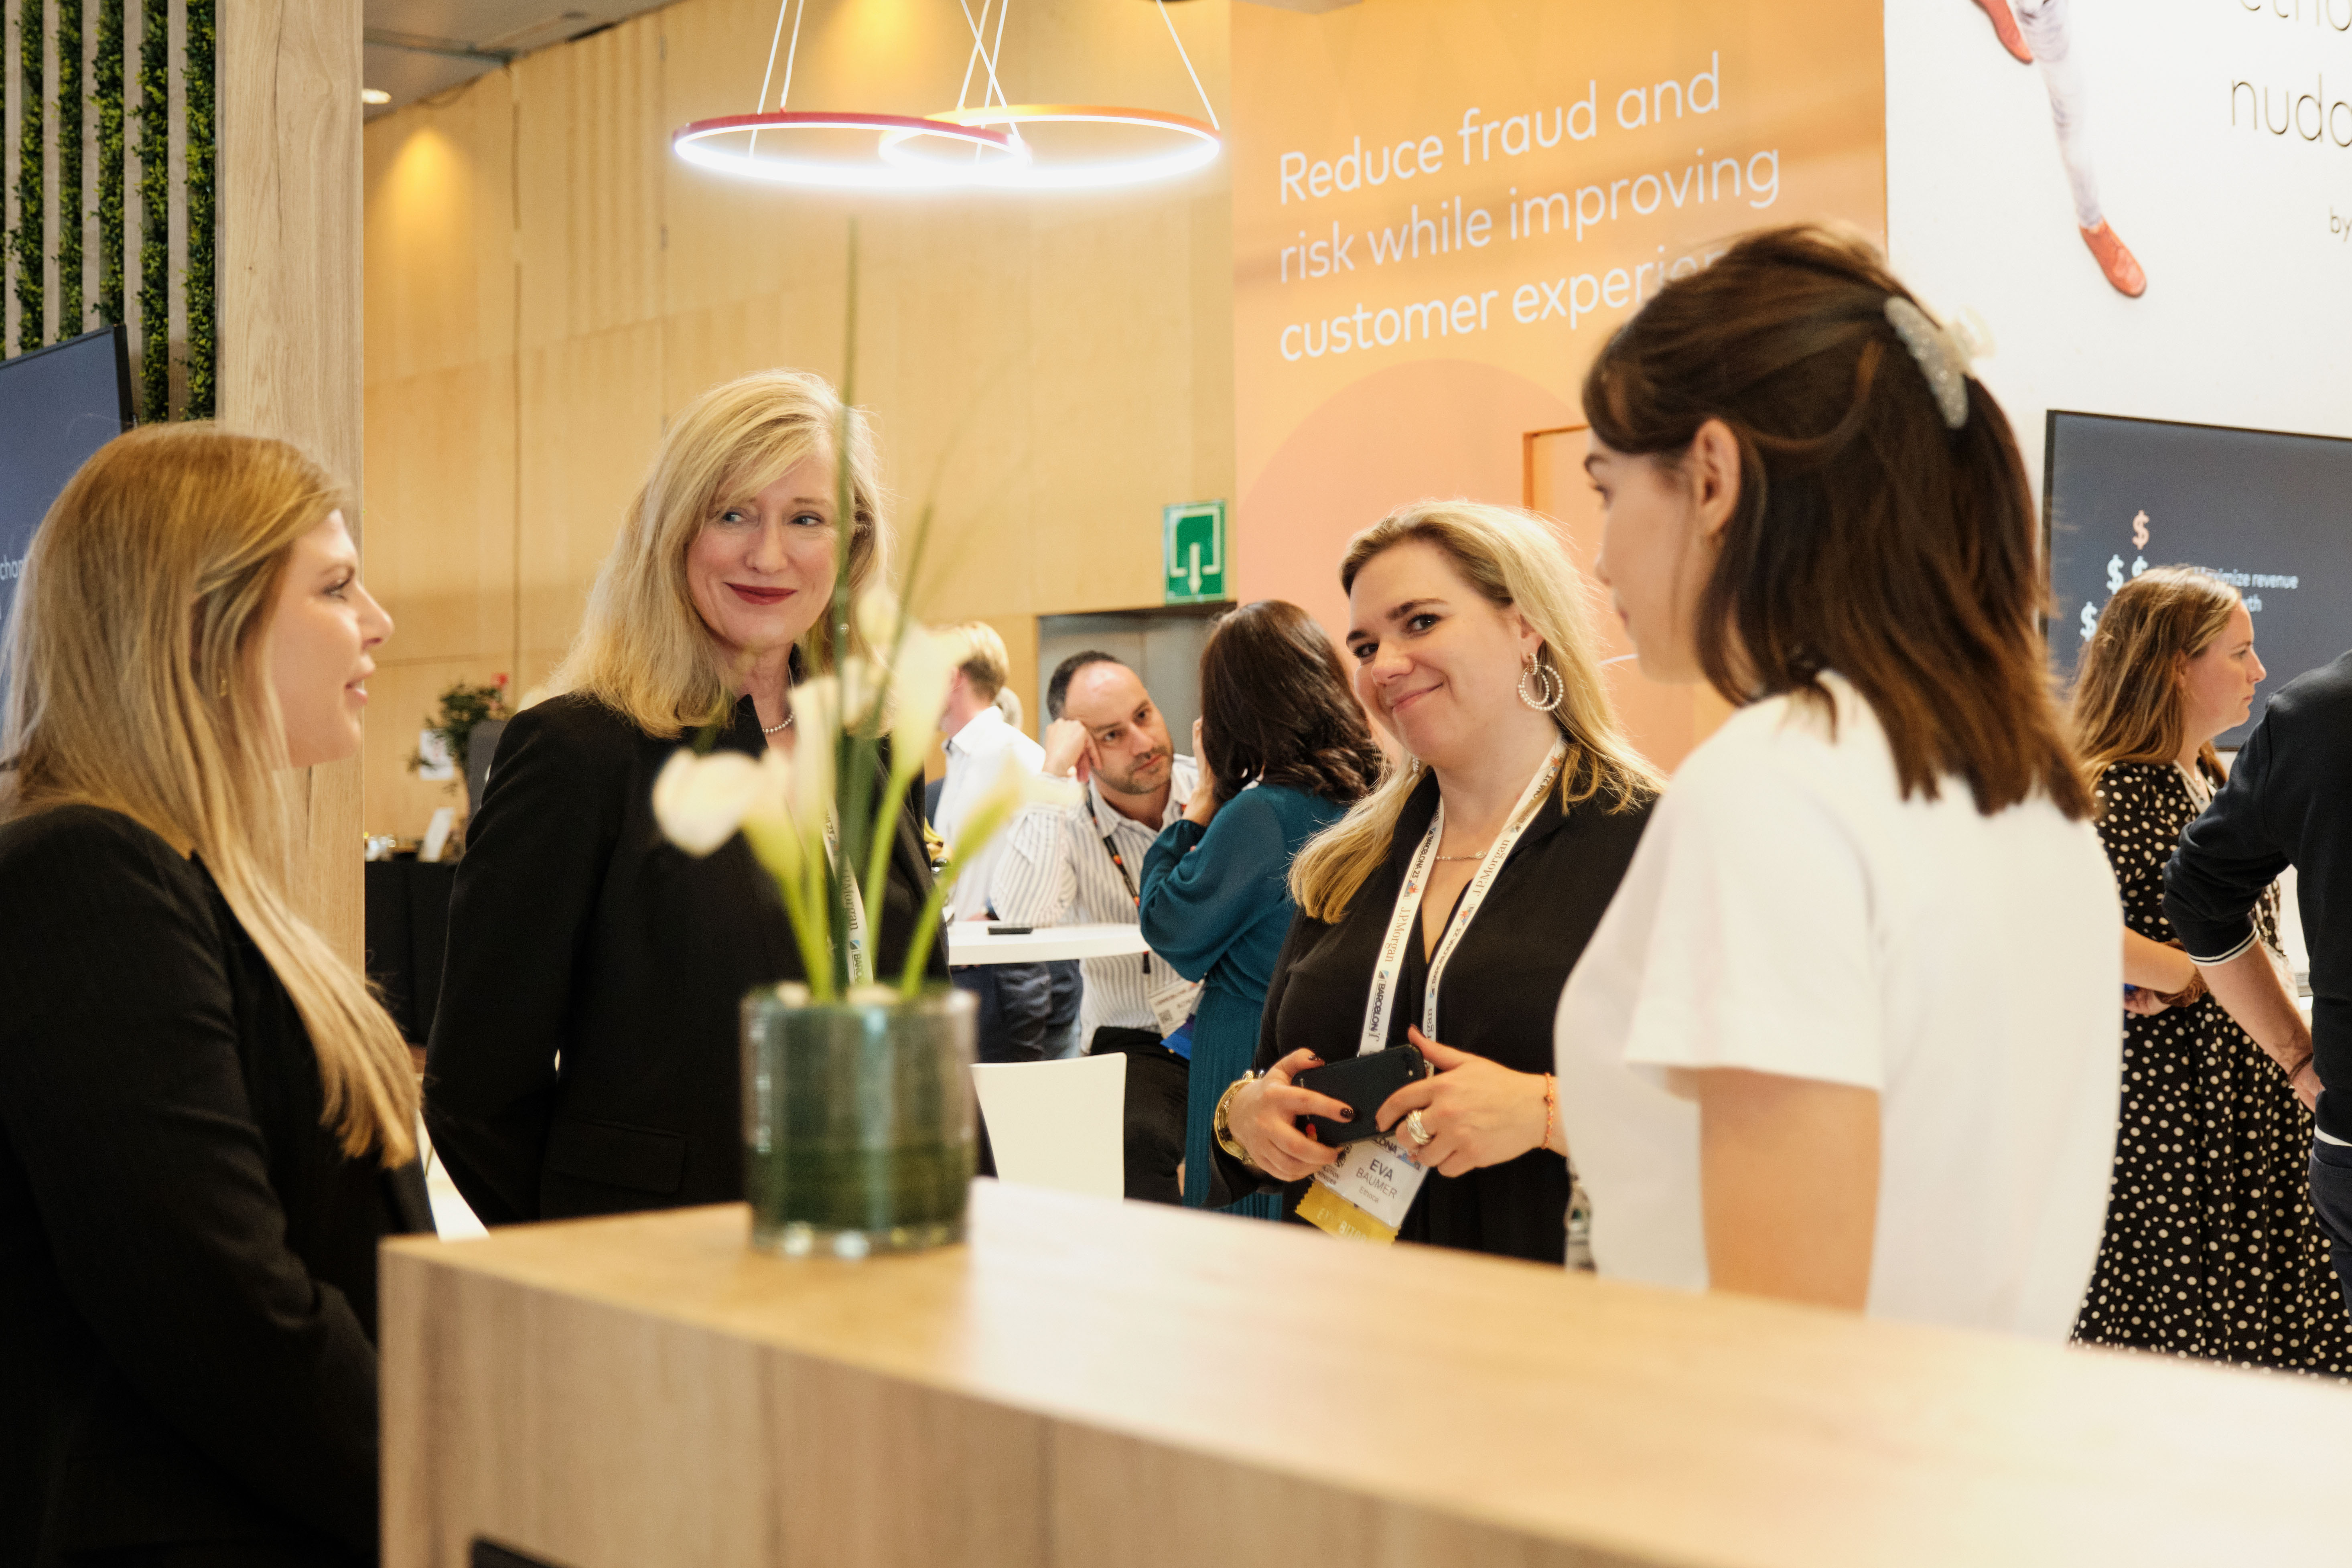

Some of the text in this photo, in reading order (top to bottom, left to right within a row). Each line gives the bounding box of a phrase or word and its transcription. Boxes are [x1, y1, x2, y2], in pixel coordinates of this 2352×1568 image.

[1280, 50, 1719, 205] Reduce fraud and
[1280, 148, 1779, 283] risk while improving
[1280, 290, 1498, 361] customer
[2252, 574, 2299, 589] revenue
[1412, 870, 1421, 878] 23
[1473, 839, 1510, 897] J.P.Morgan
[1385, 907, 1410, 962] J.P.Morgan
[1454, 927, 1461, 938] 23
[1370, 983, 1386, 1031] BARCELON
[1356, 1167, 1397, 1199] BAUMER
[1370, 1158, 1393, 1182] EVA
